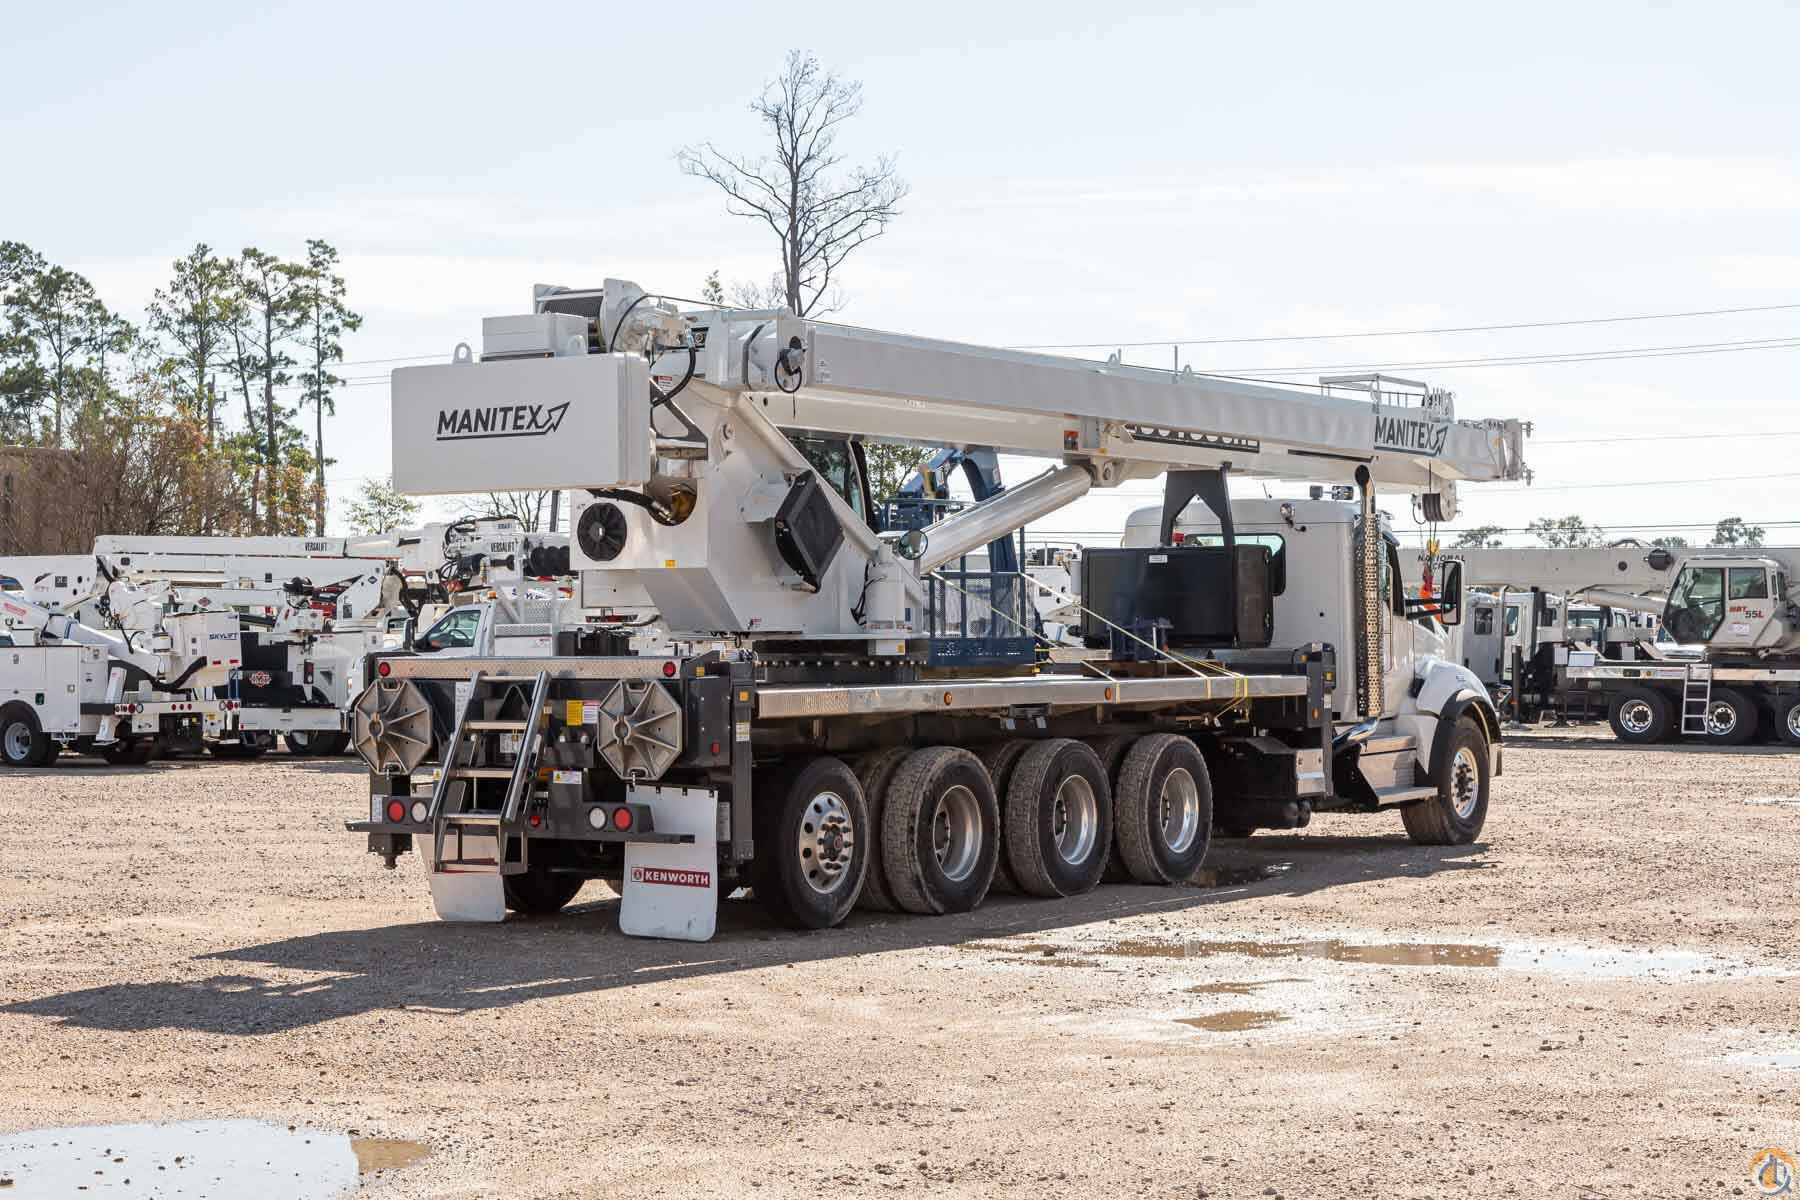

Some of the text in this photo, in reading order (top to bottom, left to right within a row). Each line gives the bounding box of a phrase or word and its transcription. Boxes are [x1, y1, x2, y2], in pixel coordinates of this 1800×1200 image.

[437, 404, 544, 435] MANITEX
[1374, 415, 1435, 449] MANITEX
[209, 632, 238, 640] SKYLIFT
[645, 871, 709, 885] KENWORTH
